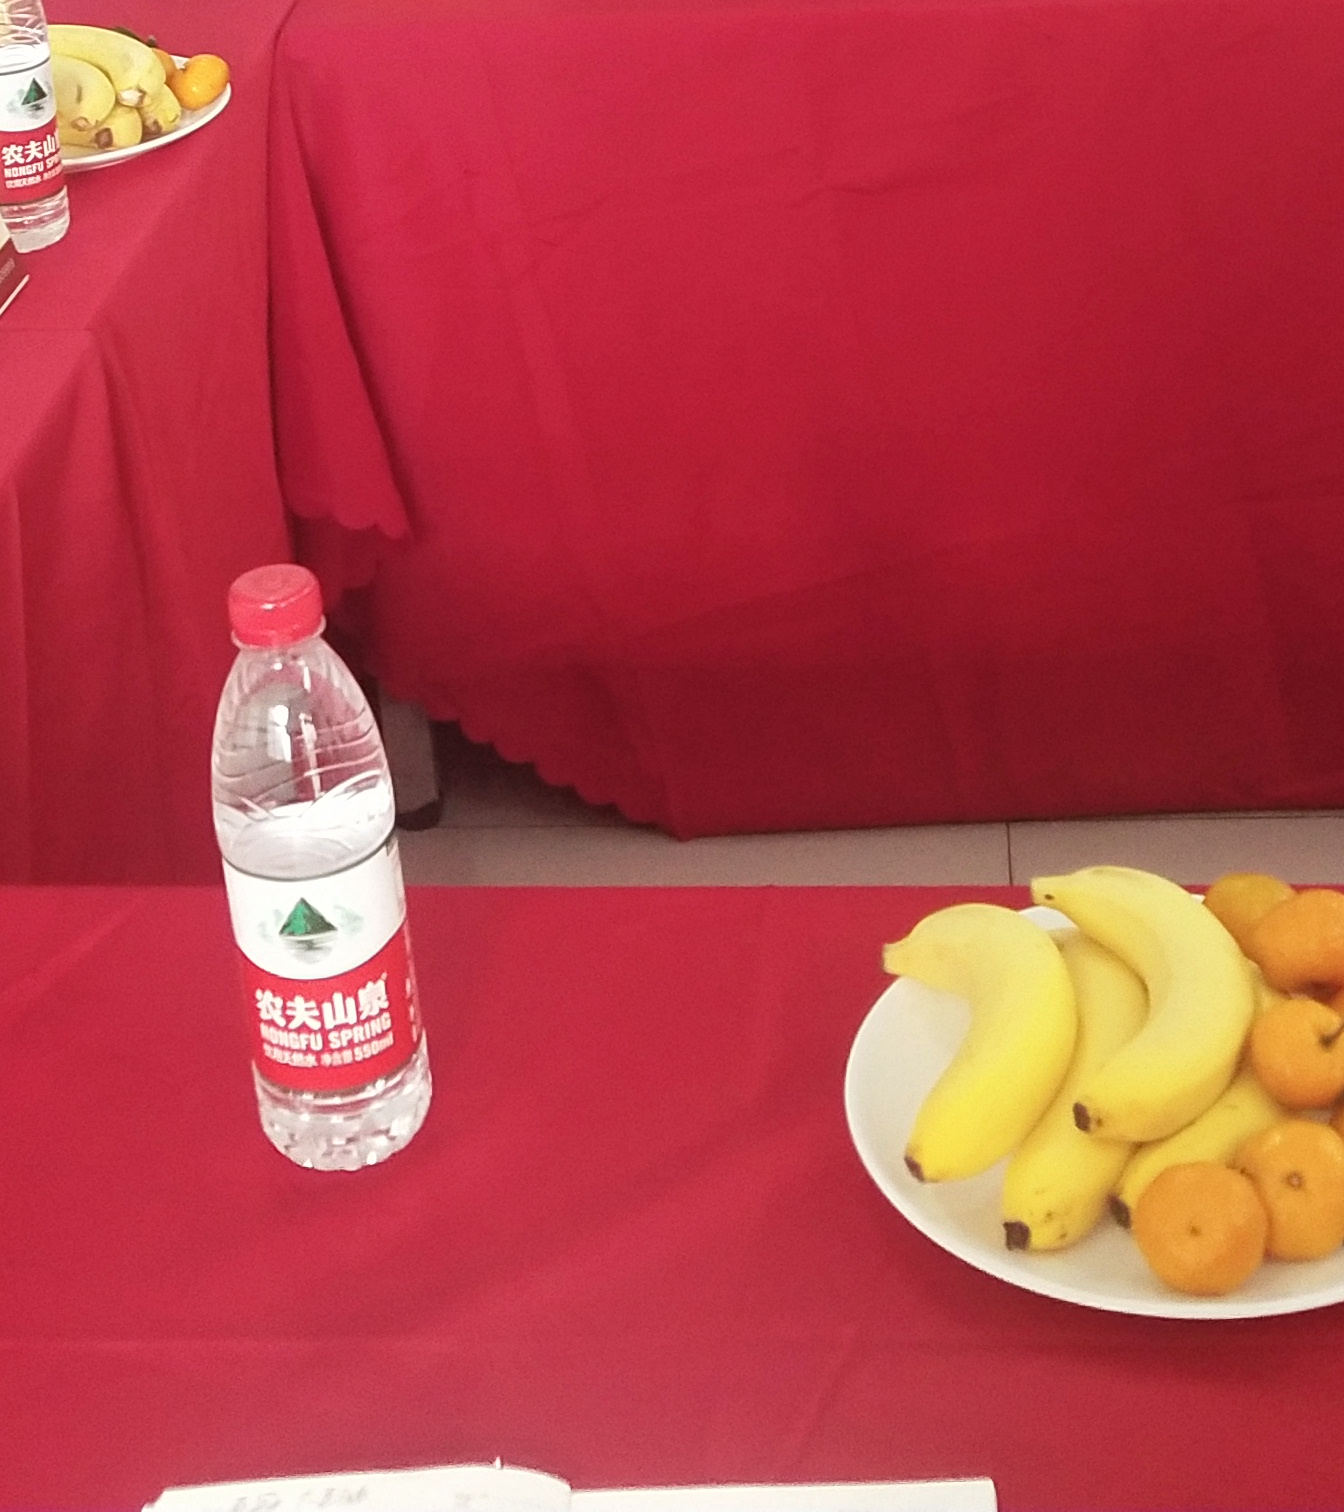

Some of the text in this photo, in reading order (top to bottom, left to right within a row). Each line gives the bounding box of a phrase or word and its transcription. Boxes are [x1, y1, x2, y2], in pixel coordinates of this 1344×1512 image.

[255, 978, 390, 1031] 农夫山泉
[259, 1011, 392, 1052] NONGFU SPRING
